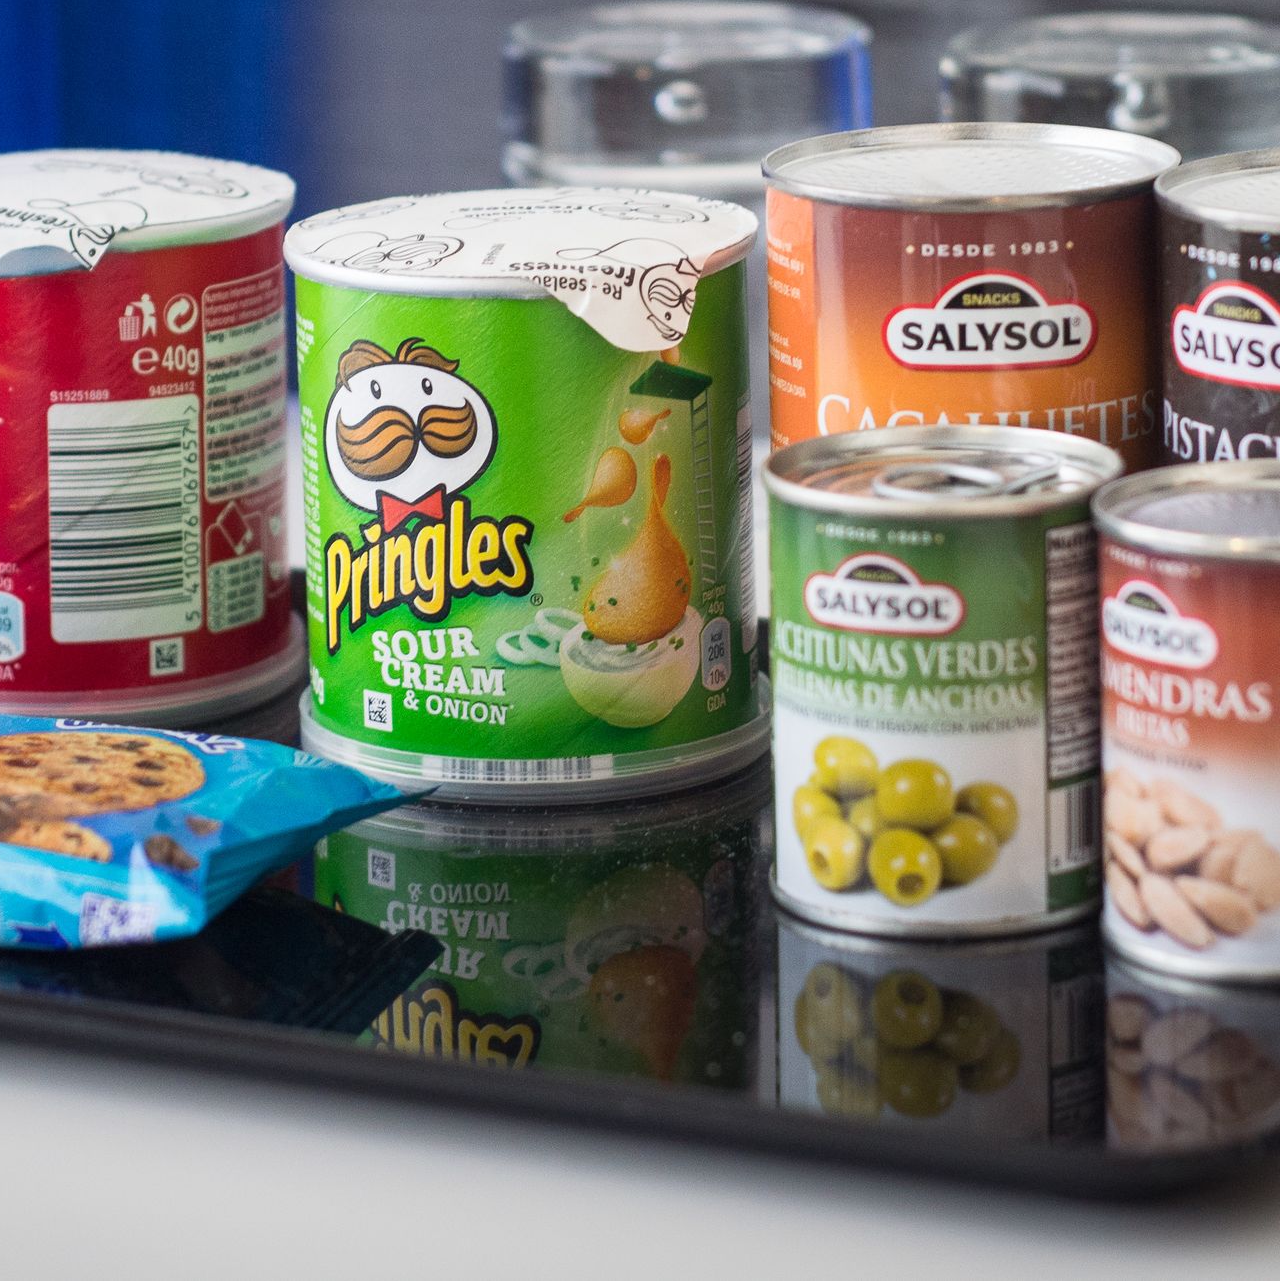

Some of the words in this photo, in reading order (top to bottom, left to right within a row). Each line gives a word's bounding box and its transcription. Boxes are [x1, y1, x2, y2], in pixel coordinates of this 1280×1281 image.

[921, 244, 996, 257] DESDE
[1009, 240, 1059, 256] 1983
[1188, 244, 1240, 268] DESDE
[962, 292, 1021, 306] SNACKS
[902, 317, 1082, 352] SALYSOL
[326, 498, 533, 652] Pringles
[817, 587, 948, 622] SALYSOL
[372, 626, 480, 664] SOUR
[913, 636, 1037, 680] VERDES
[381, 653, 506, 697] CREAM
[403, 690, 419, 711] &
[426, 693, 509, 726] ONION
